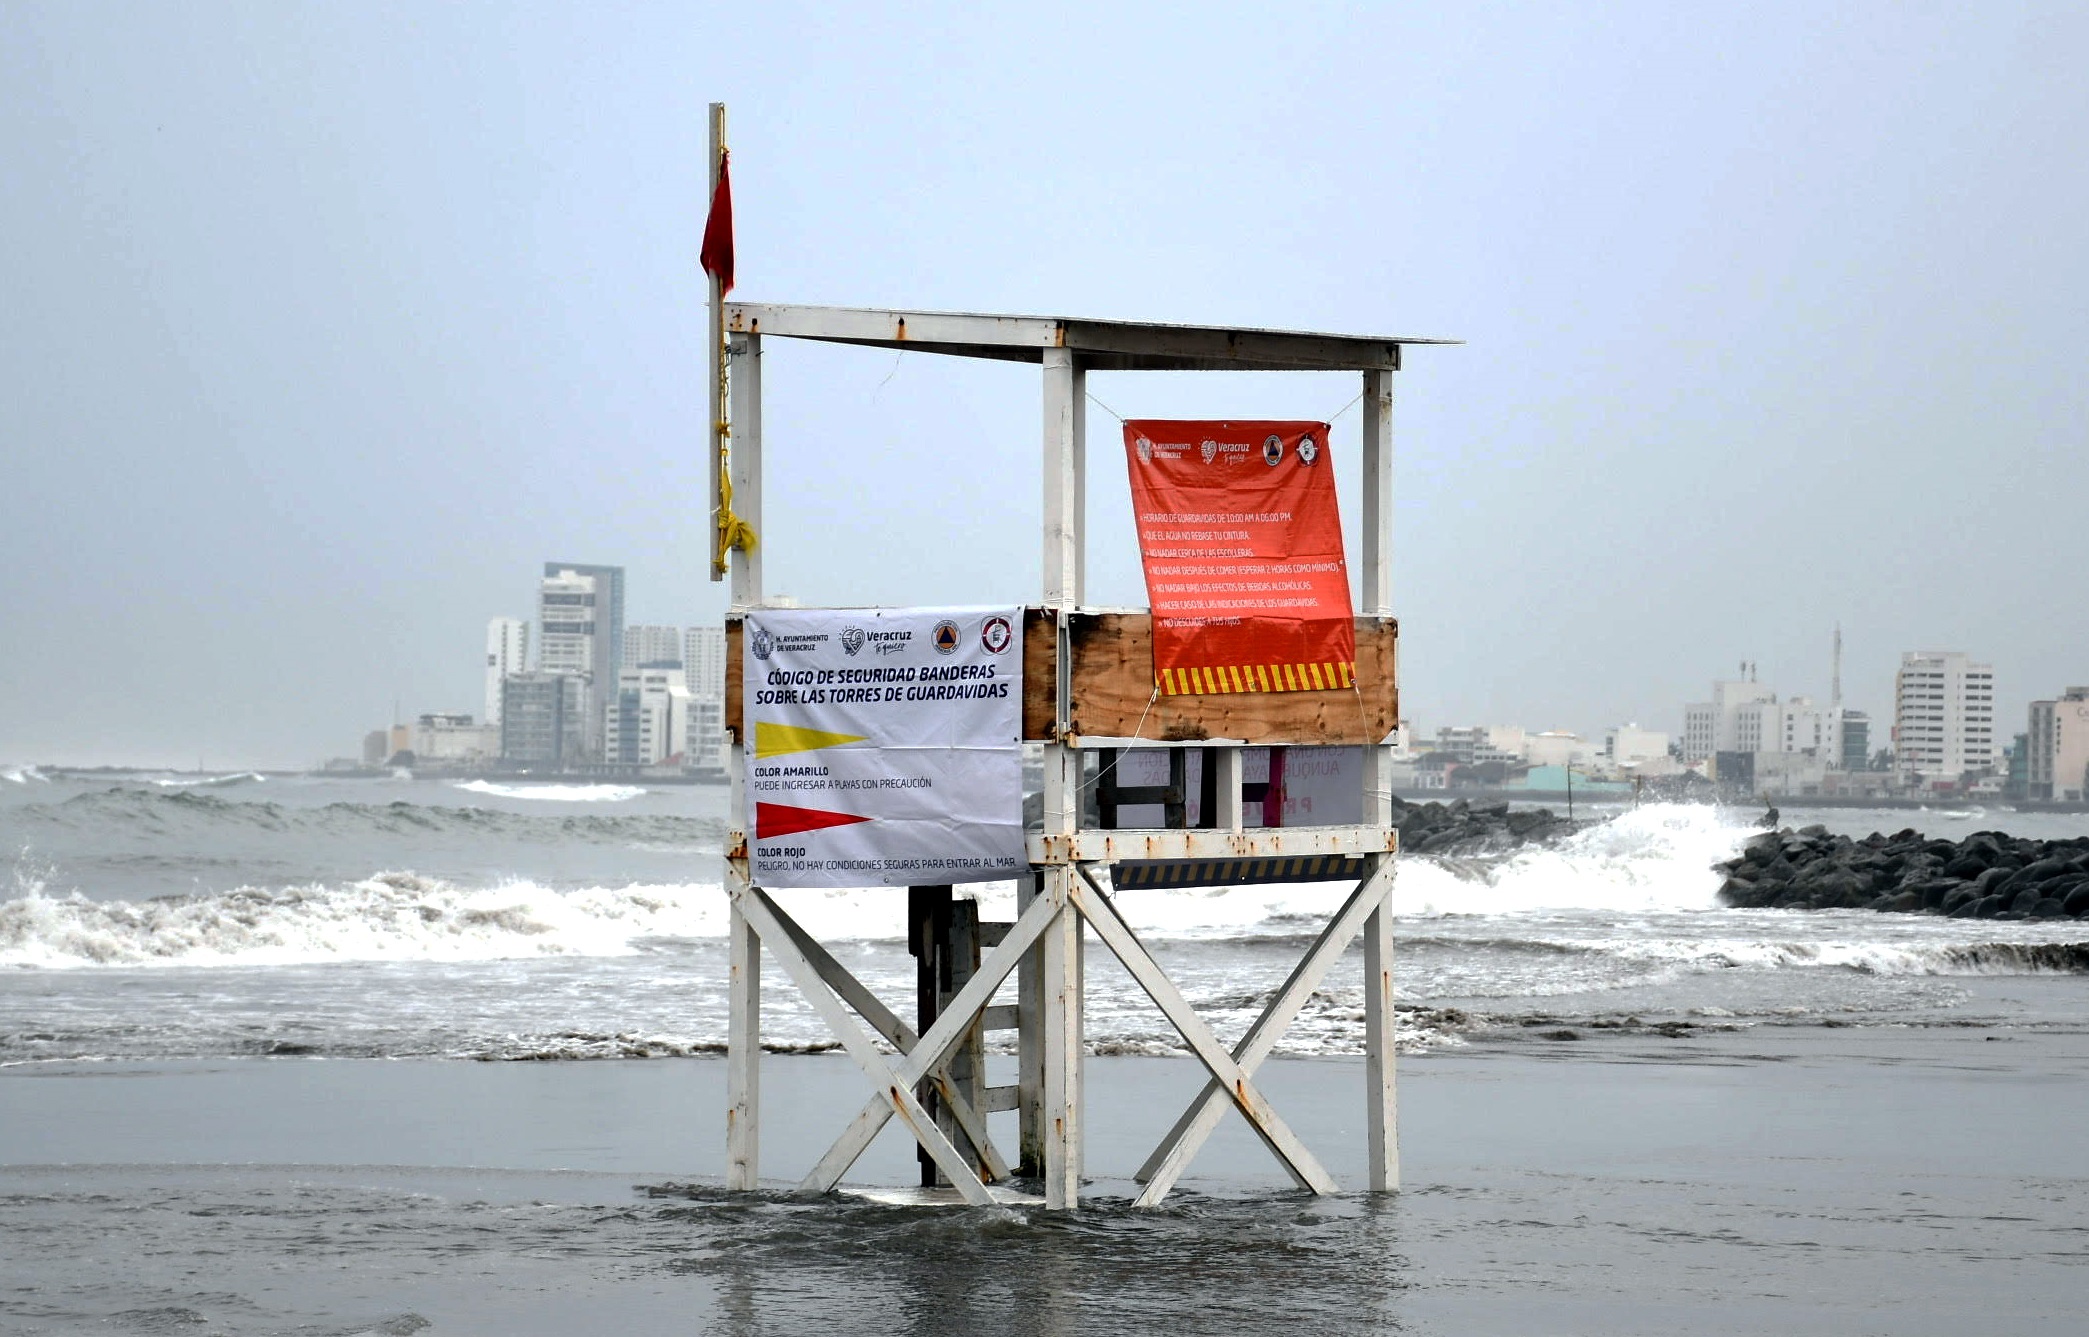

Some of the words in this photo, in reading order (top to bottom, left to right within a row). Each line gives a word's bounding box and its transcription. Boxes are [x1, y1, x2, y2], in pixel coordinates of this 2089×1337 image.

[1218, 442, 1250, 452] Veracruz
[1143, 513, 1168, 522] HORARIO
[1169, 513, 1178, 522] DE
[1178, 513, 1216, 523] GUARDAVIDAS
[1217, 513, 1226, 522] DE
[1227, 513, 1244, 522] 10:00
[1245, 513, 1254, 522] AM
[1255, 513, 1260, 522] A
[1146, 531, 1157, 540] QUE
[1157, 531, 1165, 540] EL
[1165, 531, 1181, 540] AGUA
[1181, 531, 1190, 540] NO
[1191, 531, 1213, 540] REBASE
[1214, 531, 1222, 540] TU
[1150, 549, 1157, 557] NO
[1157, 549, 1178, 557] NADAR
[1178, 549, 1196, 557] CERCA
[1197, 549, 1204, 557] DE
[1205, 549, 1216, 557] LAS
[1152, 566, 1160, 575] NO
[1161, 566, 1180, 575] NADAR
[1208, 566, 1216, 575] DE
[1216, 565, 1236, 575] COMER
[1266, 565, 1270, 574] 2
[1271, 564, 1292, 573] HORAS
[1293, 564, 1311, 573] COMO
[1156, 584, 1164, 592] NO
[1164, 584, 1185, 592] NADAR
[1202, 583, 1211, 592] LOS
[1212, 582, 1236, 592] EFECTOS
[1237, 582, 1246, 591] DE
[1246, 582, 1271, 591] BEBIDAS
[1160, 600, 1180, 609] HACER
[1180, 600, 1197, 609] CASO
[1258, 599, 1266, 608] DE
[1267, 599, 1278, 608] LOS
[1164, 619, 1173, 628] NO
[783, 634, 829, 642] AYUNTAMIENTO
[866, 630, 912, 642] Veracruz
[784, 644, 816, 652] VERACRUZ
[767, 667, 814, 686] CÓDIGO
[816, 669, 834, 685] DE
[838, 666, 916, 684] SEGURIDAD
[919, 664, 997, 682] BANDERAS
[756, 690, 798, 705] SOBRE
[801, 688, 826, 704] LAS
[830, 687, 882, 703] TORRES
[884, 686, 903, 702] DE
[906, 683, 1009, 701] GUARDAVIDAS
[754, 767, 781, 778] COLOR
[783, 766, 829, 777] AMARILLO
[754, 780, 780, 791] PUEDE
[782, 779, 826, 790] INGRESAR
[828, 780, 834, 790] A
[834, 778, 860, 790] PLAYAS
[862, 778, 878, 789] CON
[880, 776, 932, 789] PRECAUCIÓN
[757, 847, 782, 858] COLOR
[784, 846, 806, 858] ROJO
[792, 860, 805, 871] NO
[806, 860, 824, 870] HAY
[826, 859, 882, 870] CONDICIONES
[884, 858, 920, 870] SEGURAS
[922, 858, 946, 870] PARA
[946, 858, 981, 869] ENTRAR
[982, 858, 995, 868] AL
[996, 857, 1017, 868] MAR
